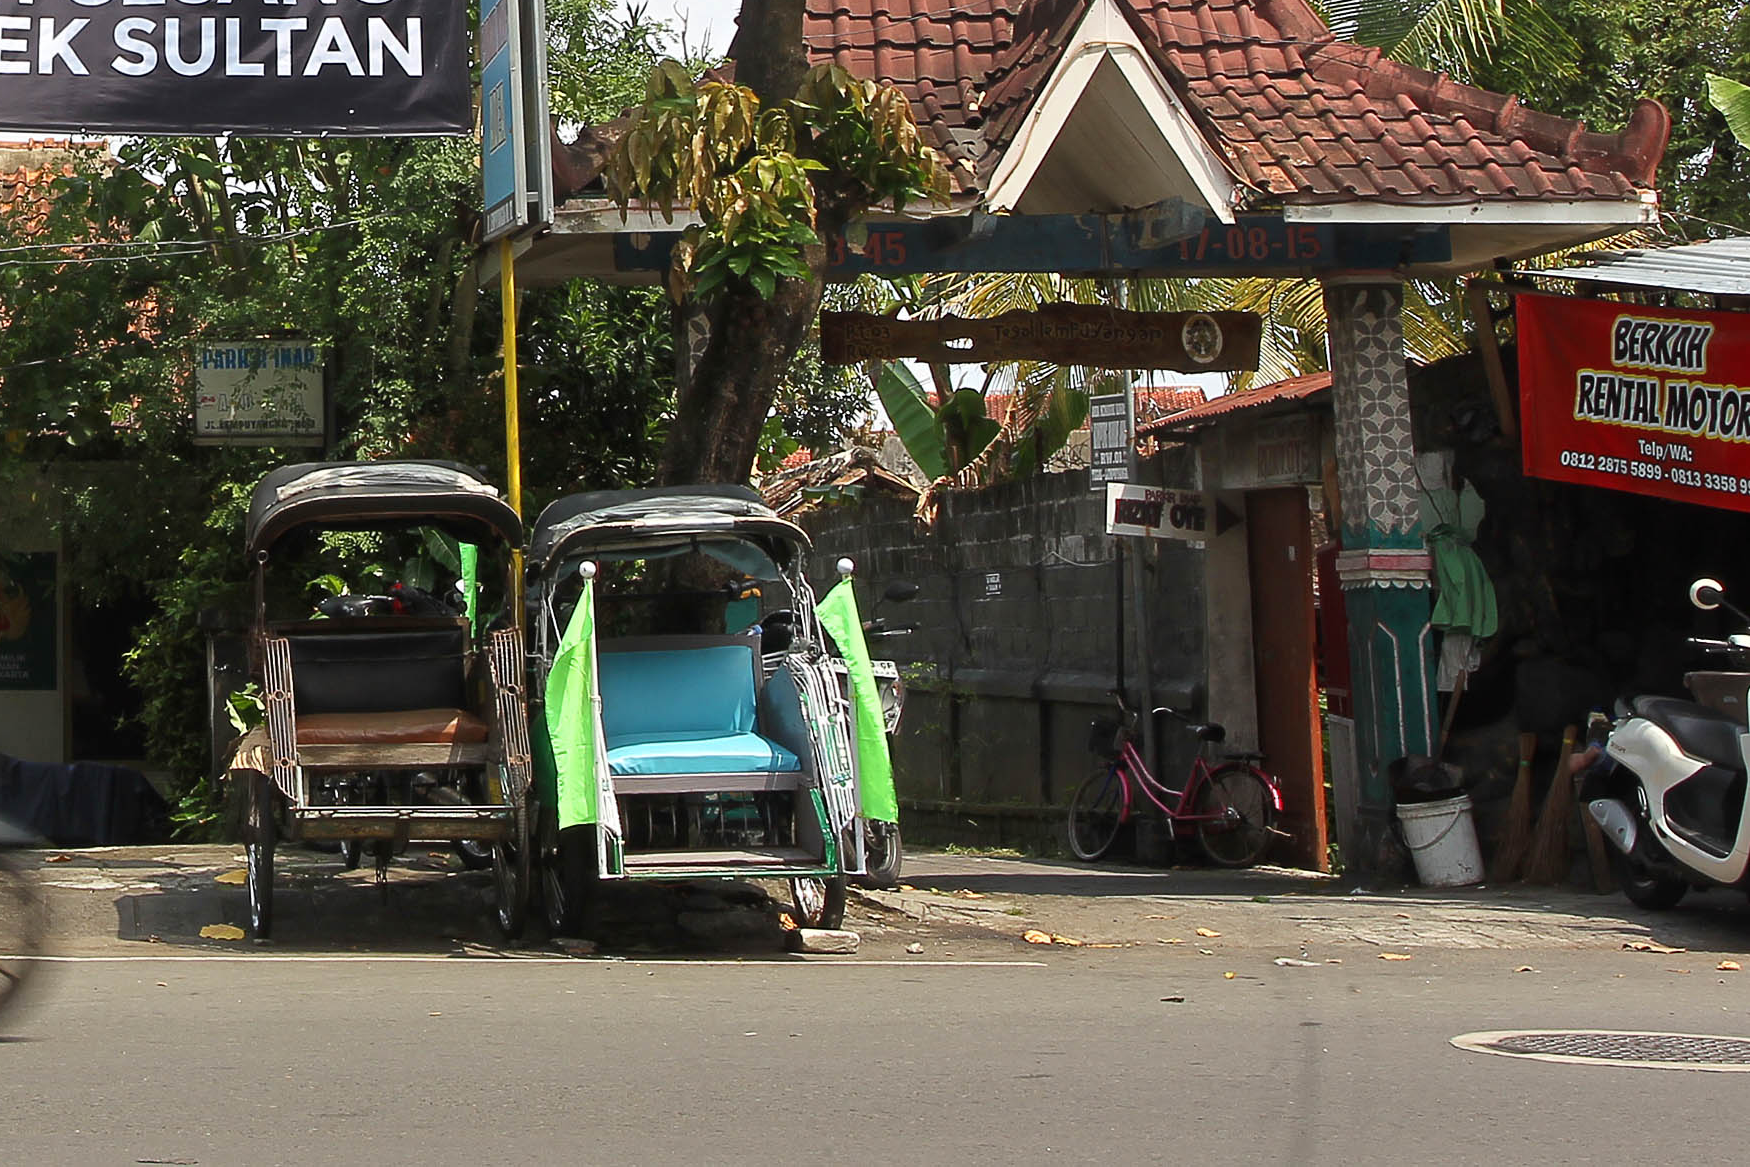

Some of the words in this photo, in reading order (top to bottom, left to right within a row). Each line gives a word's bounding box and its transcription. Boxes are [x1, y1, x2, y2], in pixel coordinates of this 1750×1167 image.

[112, 16, 424, 77] SULTAN
[202, 348, 266, 369] PARKR
[1613, 315, 1713, 372] BERKAH
[1576, 372, 1661, 426] RENTAL
[1664, 381, 1750, 441] MOTOR
[1560, 450, 1595, 470] 0812
[1598, 456, 1628, 475] 2875
[1631, 461, 1661, 480] 5899
[1671, 468, 1701, 487] 0813
[1704, 474, 1736, 493] 3358
[1638, 439, 1693, 462] Telp/WA:
